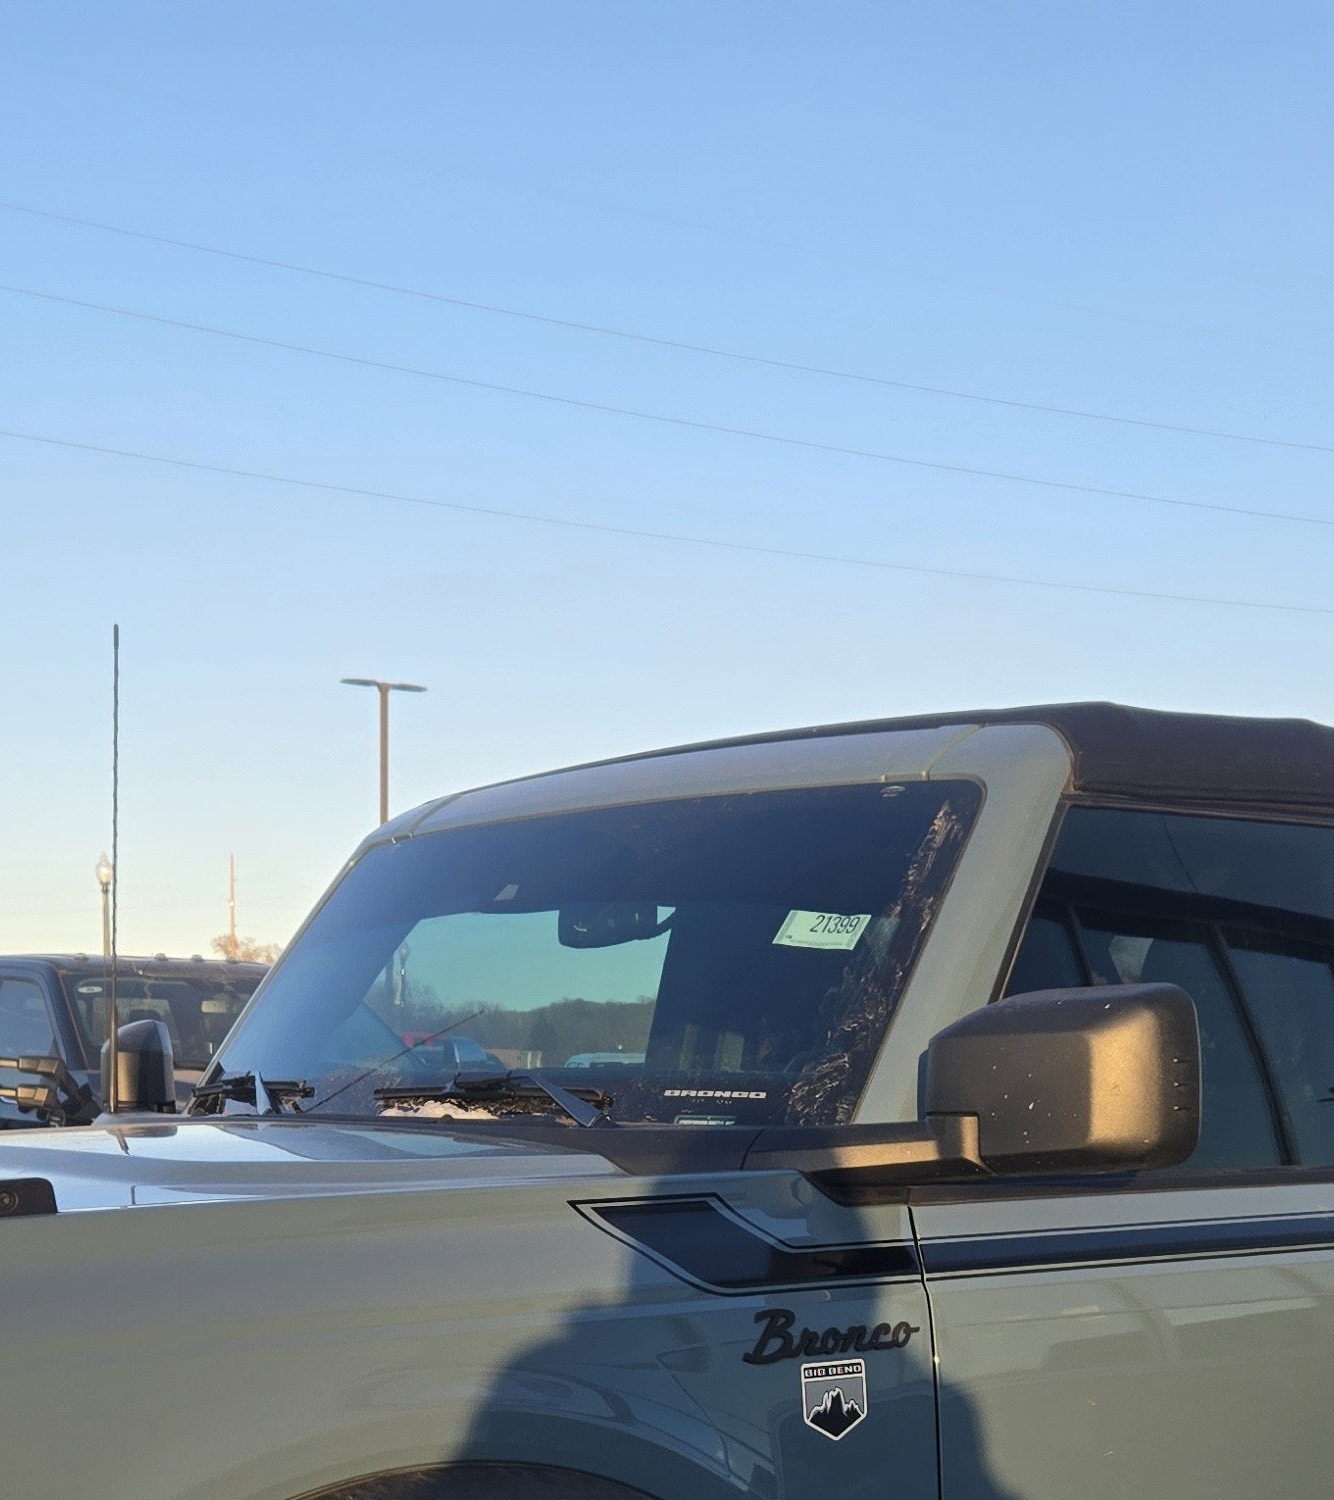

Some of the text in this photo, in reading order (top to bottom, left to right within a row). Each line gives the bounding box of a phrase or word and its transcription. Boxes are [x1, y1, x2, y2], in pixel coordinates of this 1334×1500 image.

[809, 914, 861, 934] 21399
[663, 1089, 767, 1099] BRONCO
[742, 1308, 920, 1365] Bronco
[803, 1364, 862, 1378] BIG BEND
